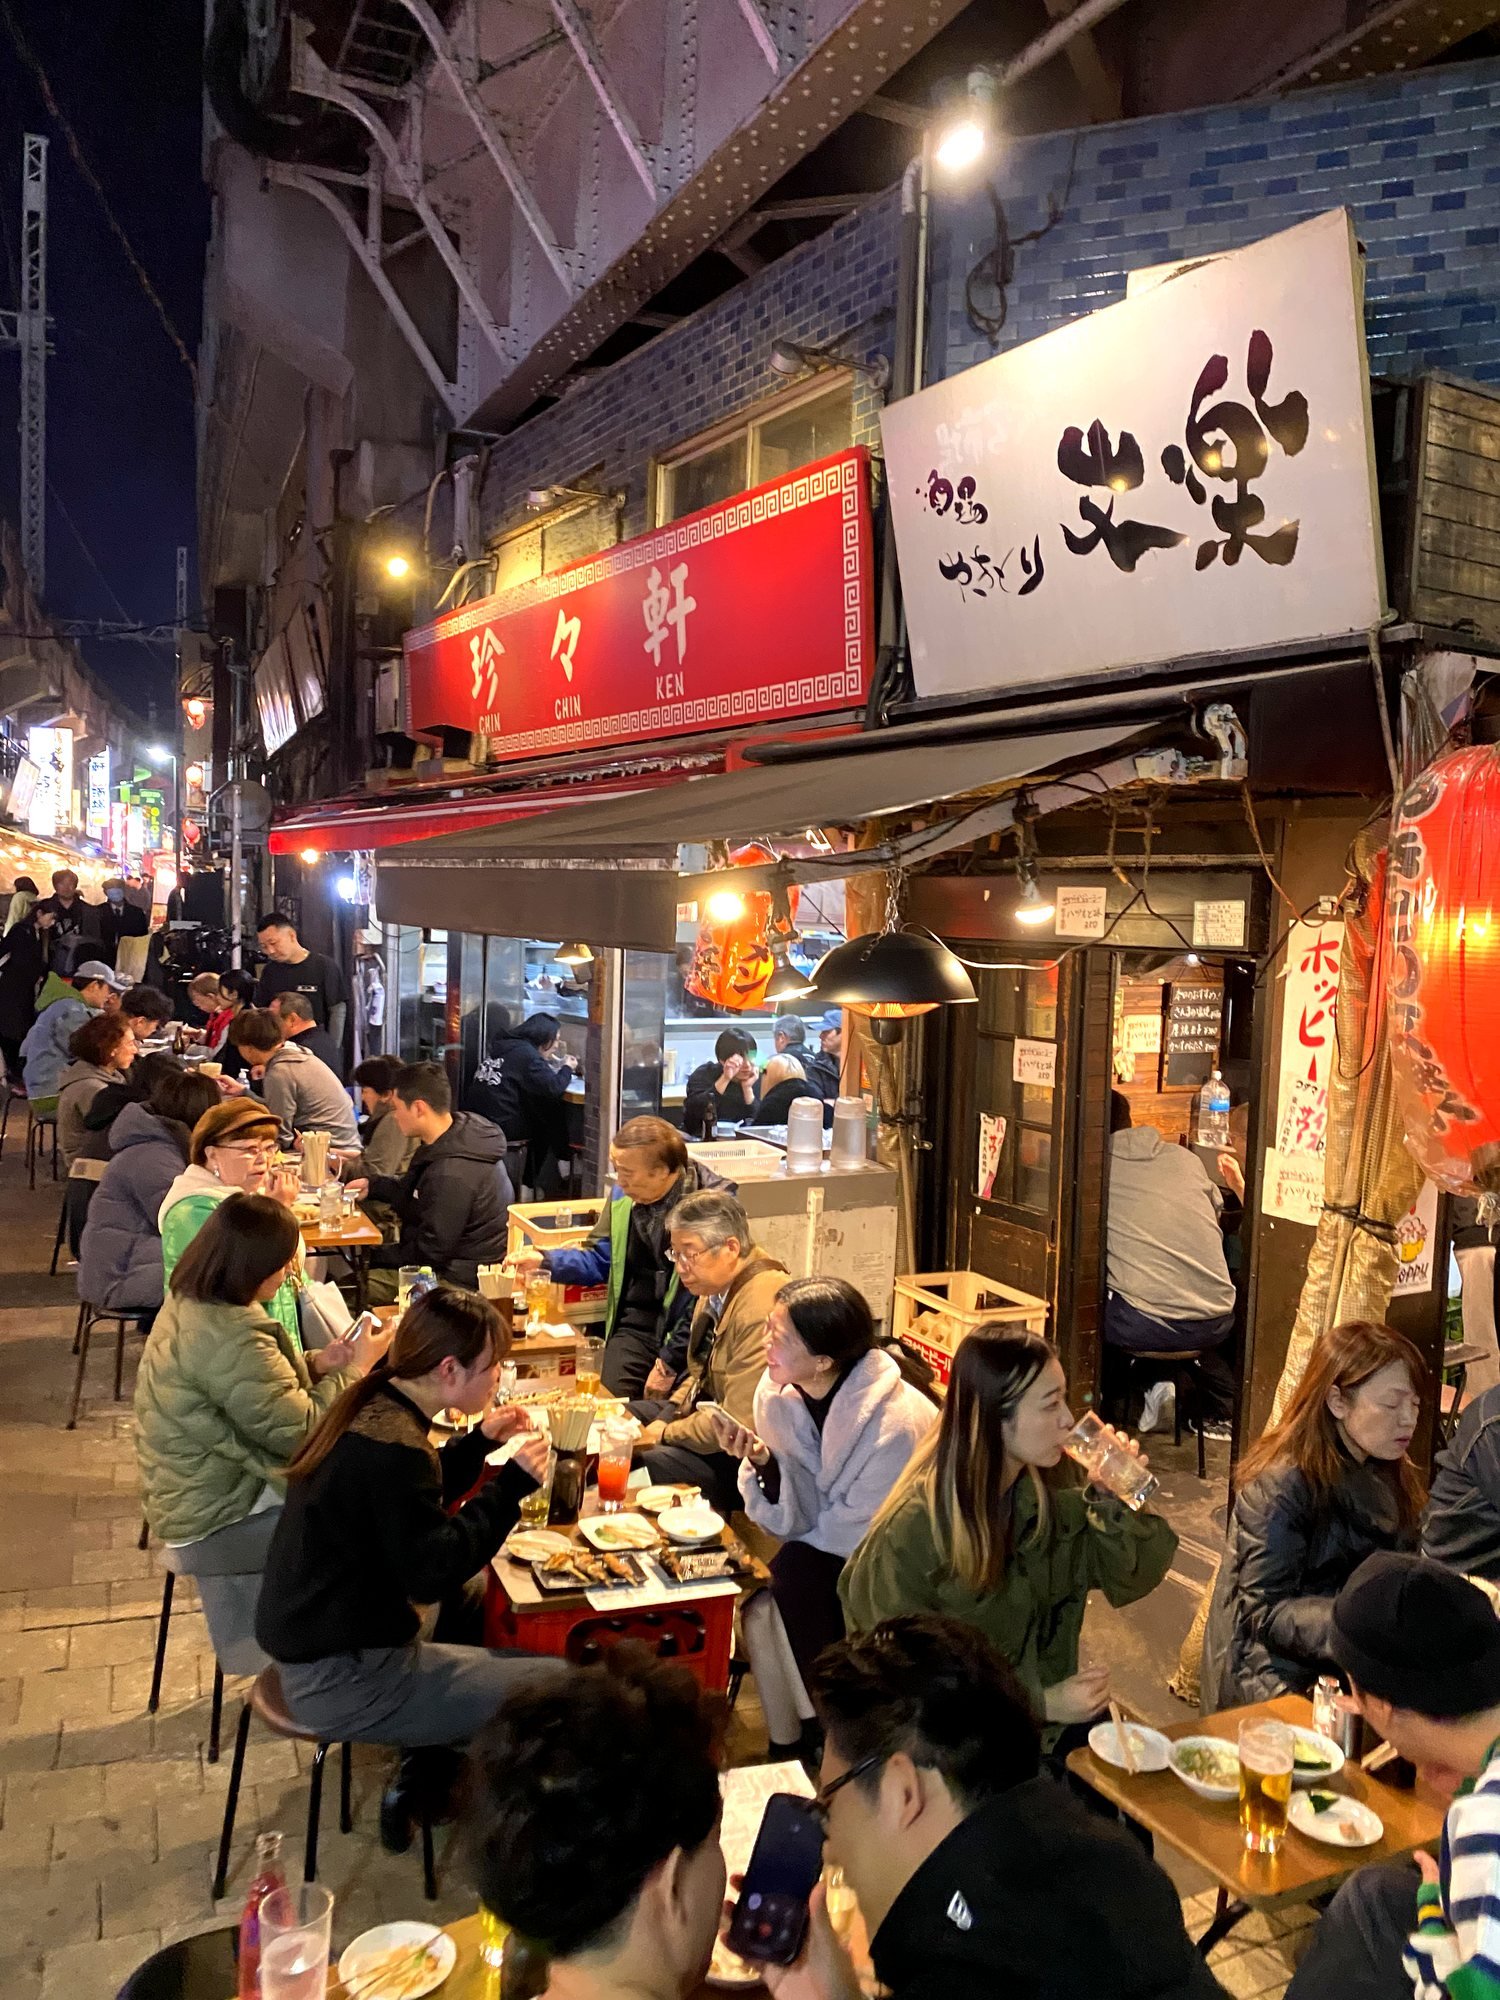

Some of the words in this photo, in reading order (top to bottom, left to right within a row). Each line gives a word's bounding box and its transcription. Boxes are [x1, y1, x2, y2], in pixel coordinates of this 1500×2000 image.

[938, 533, 1045, 603] やきとり
[469, 562, 697, 710] 珍々軒
[479, 712, 501, 735] CHIN
[554, 694, 582, 719] CHIN
[655, 671, 685, 701] KEN
[1300, 929, 1340, 1083] ホッピー
[1295, 1105, 1314, 1144] サワー
